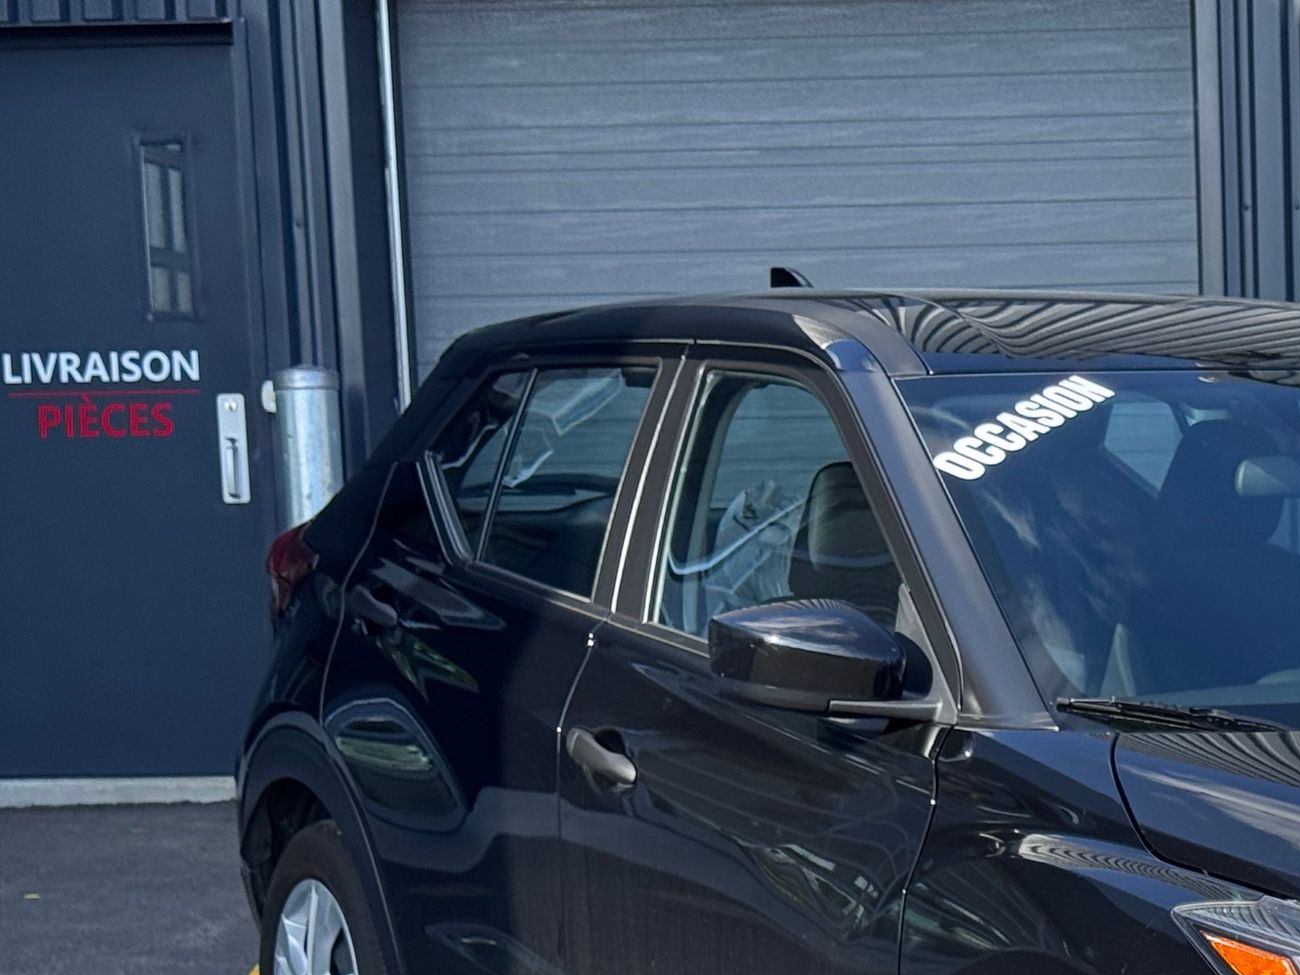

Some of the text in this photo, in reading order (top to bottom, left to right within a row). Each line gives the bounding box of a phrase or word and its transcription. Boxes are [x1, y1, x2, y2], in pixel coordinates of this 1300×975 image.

[1, 350, 200, 384] LIVRAISON
[37, 393, 176, 439] PIÈCES
[933, 374, 1116, 481] OCCASION
